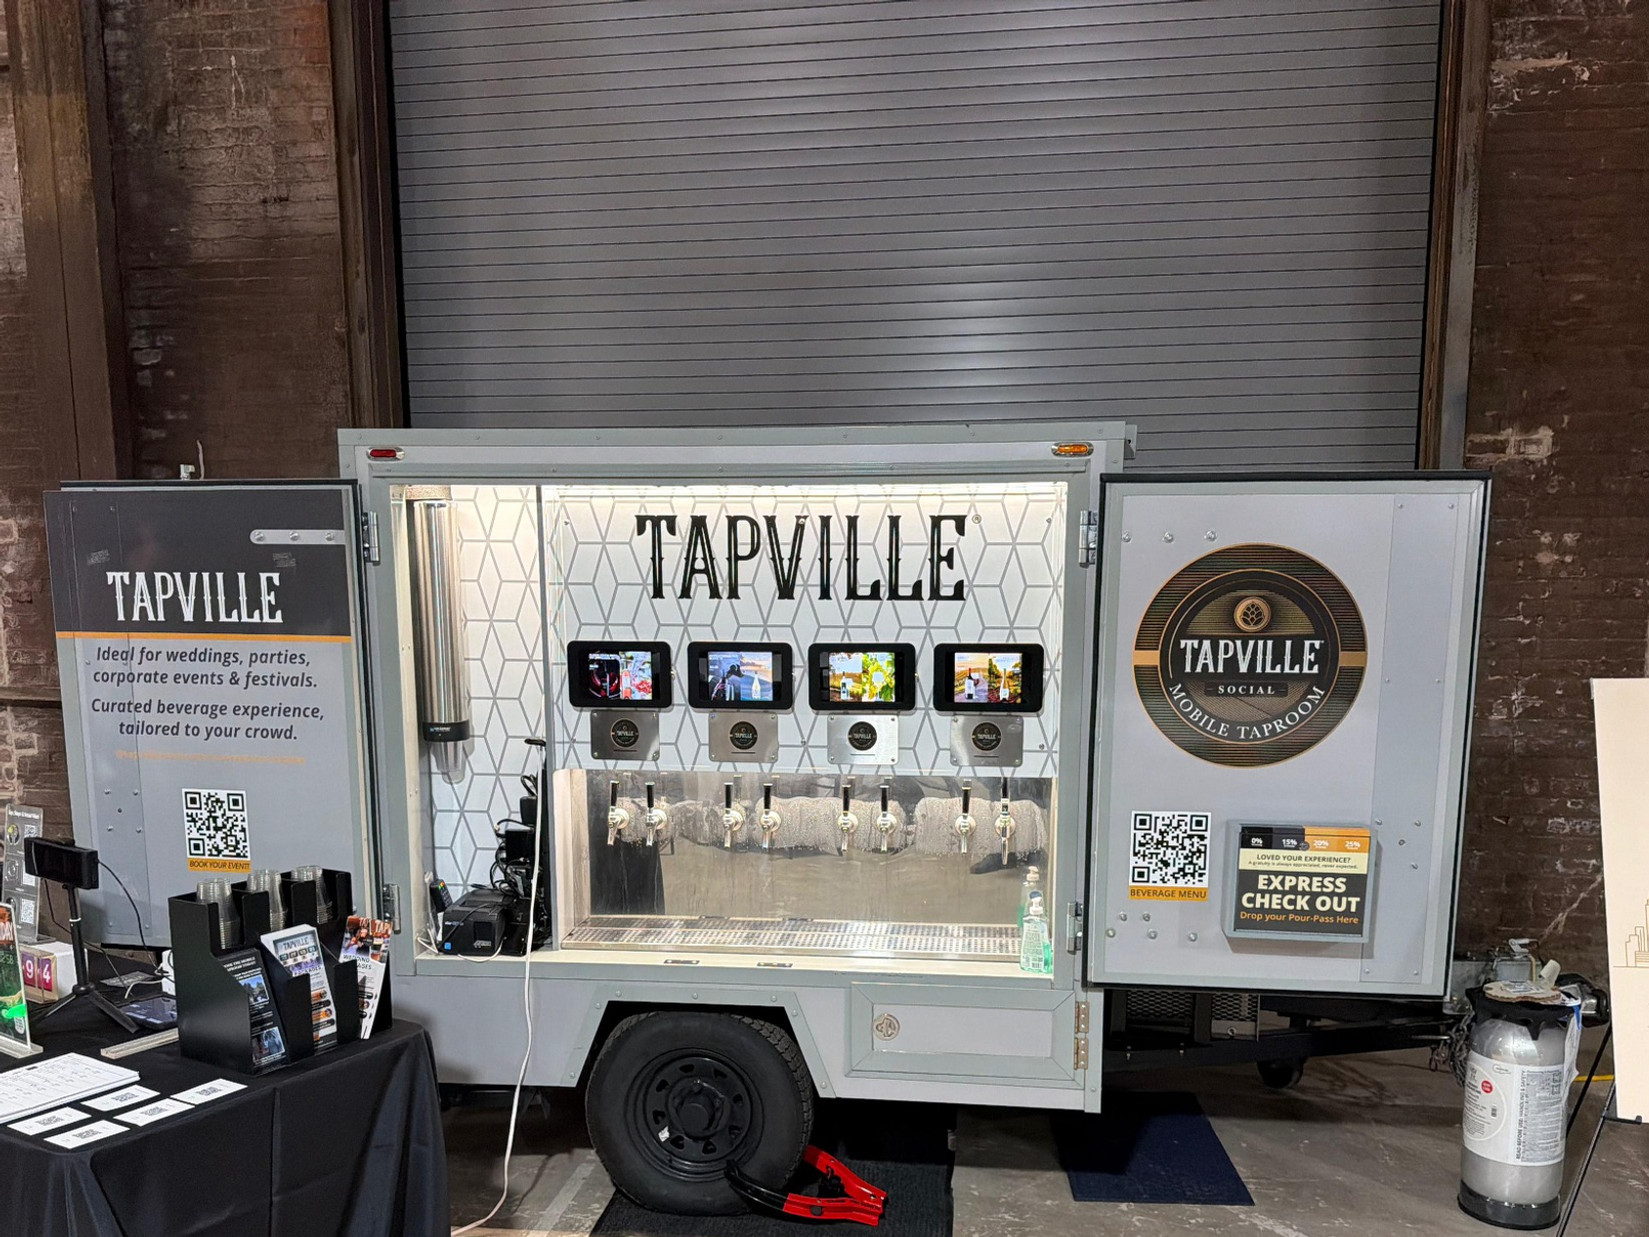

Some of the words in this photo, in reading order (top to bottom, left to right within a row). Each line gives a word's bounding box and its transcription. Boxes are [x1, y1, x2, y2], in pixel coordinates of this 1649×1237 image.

[636, 514, 967, 601] TAPVILLE
[105, 571, 284, 624] TAPVILLE
[96, 646, 135, 661] Ideal
[137, 647, 162, 666] for
[166, 647, 244, 667] weddings,
[248, 649, 311, 668] parties,
[1179, 639, 1321, 675] TAPVILLE
[93, 669, 169, 687] corporate
[173, 670, 225, 686] events
[229, 671, 241, 686] &
[243, 670, 318, 690] festivals.
[1217, 684, 1277, 696] SOCIAL
[90, 698, 153, 715] Curated
[156, 699, 228, 720] beverage
[232, 702, 325, 721] experience,
[1169, 682, 1230, 738] MOBILE
[1236, 685, 1326, 740] TAPROOM
[118, 720, 180, 737] tailored
[184, 723, 200, 737] to
[203, 725, 241, 742] your
[244, 725, 298, 741] crowd.
[189, 860, 208, 868] BOOK
[209, 861, 227, 869] YOUR
[1304, 856, 1351, 864] EXPERIENCE?
[1129, 888, 1176, 898] BEVERAGE
[1178, 890, 1207, 899] MENU
[1257, 874, 1348, 893] EXPRESS
[1241, 892, 1311, 911] CHECK
[1315, 895, 1361, 912] OUT
[1240, 911, 1263, 922] Drop
[1264, 913, 1287, 922] your
[1288, 913, 1335, 924] Pour-Pass
[1336, 916, 1359, 924] Here
